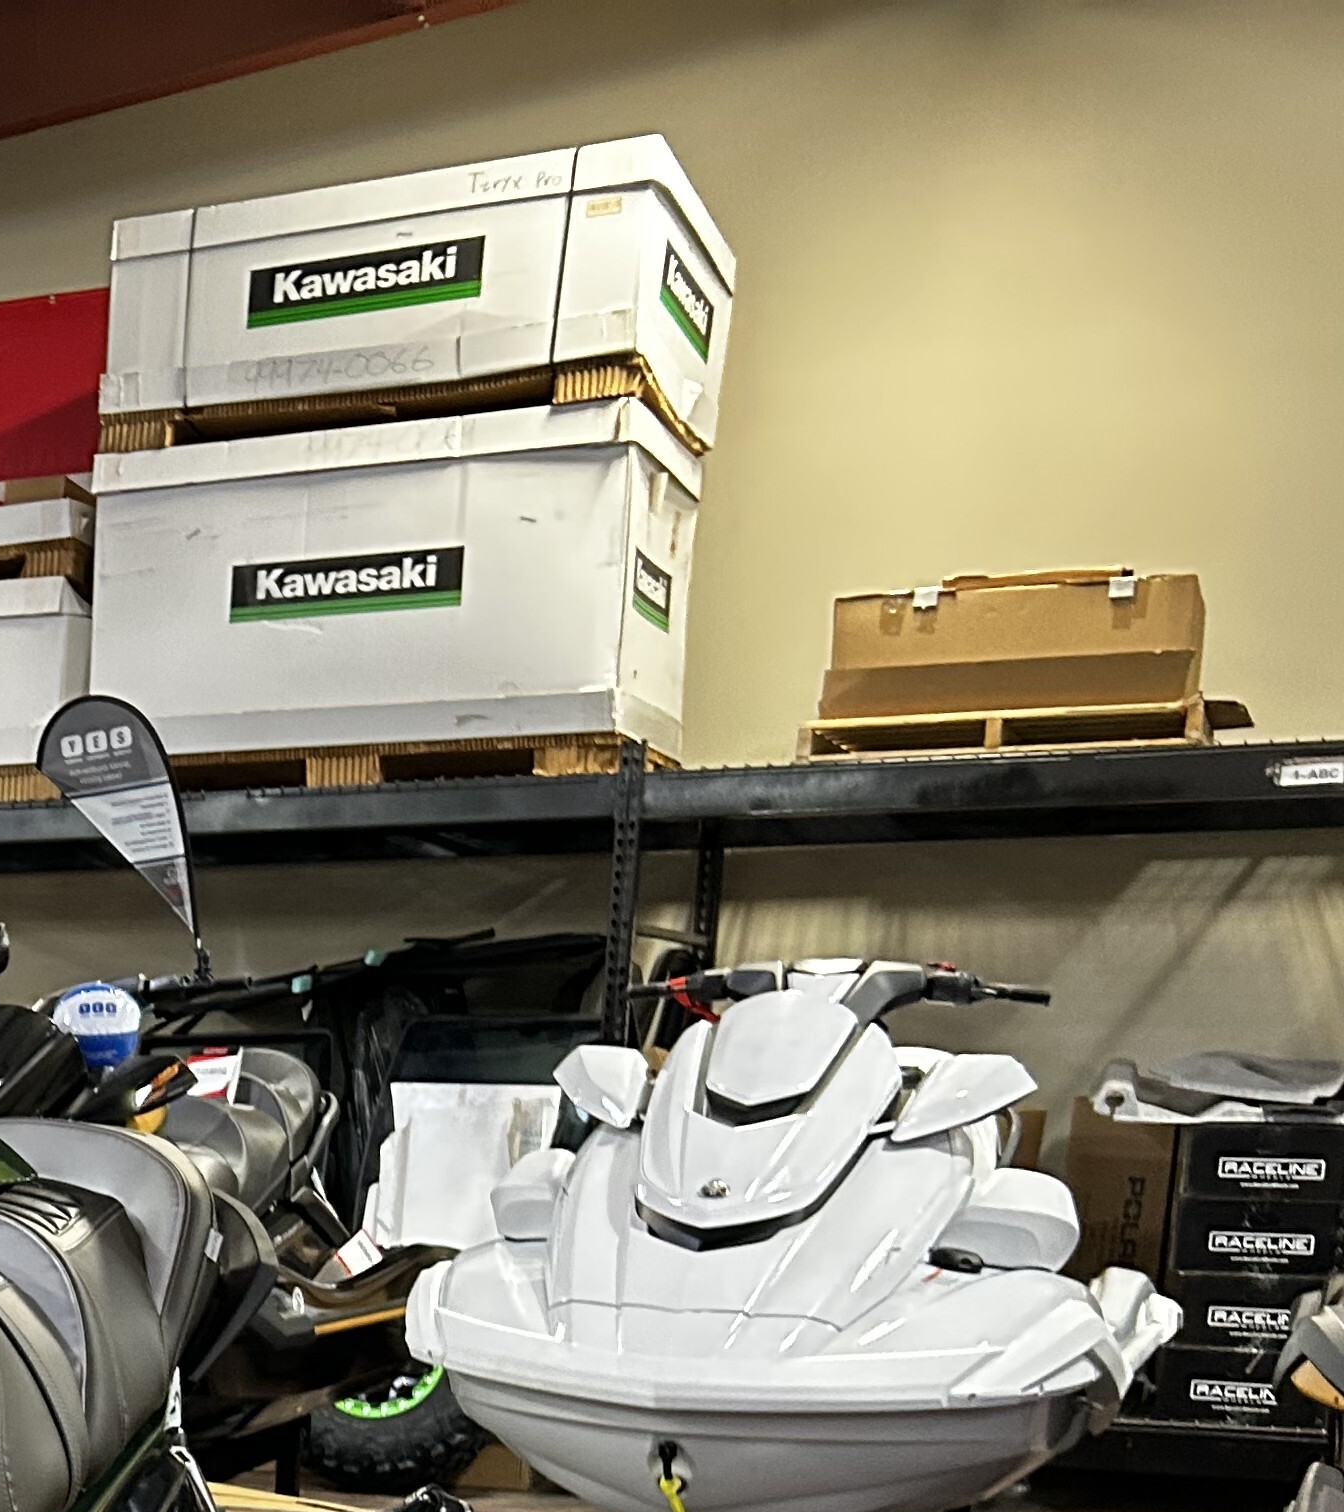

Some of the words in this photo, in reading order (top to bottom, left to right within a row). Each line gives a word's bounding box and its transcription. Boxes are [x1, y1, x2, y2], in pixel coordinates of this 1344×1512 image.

[273, 245, 459, 303] Kawasaki
[255, 554, 439, 601] Kawasaki
[1223, 1160, 1320, 1177] RACELINE
[1214, 1235, 1309, 1251] RACELINE
